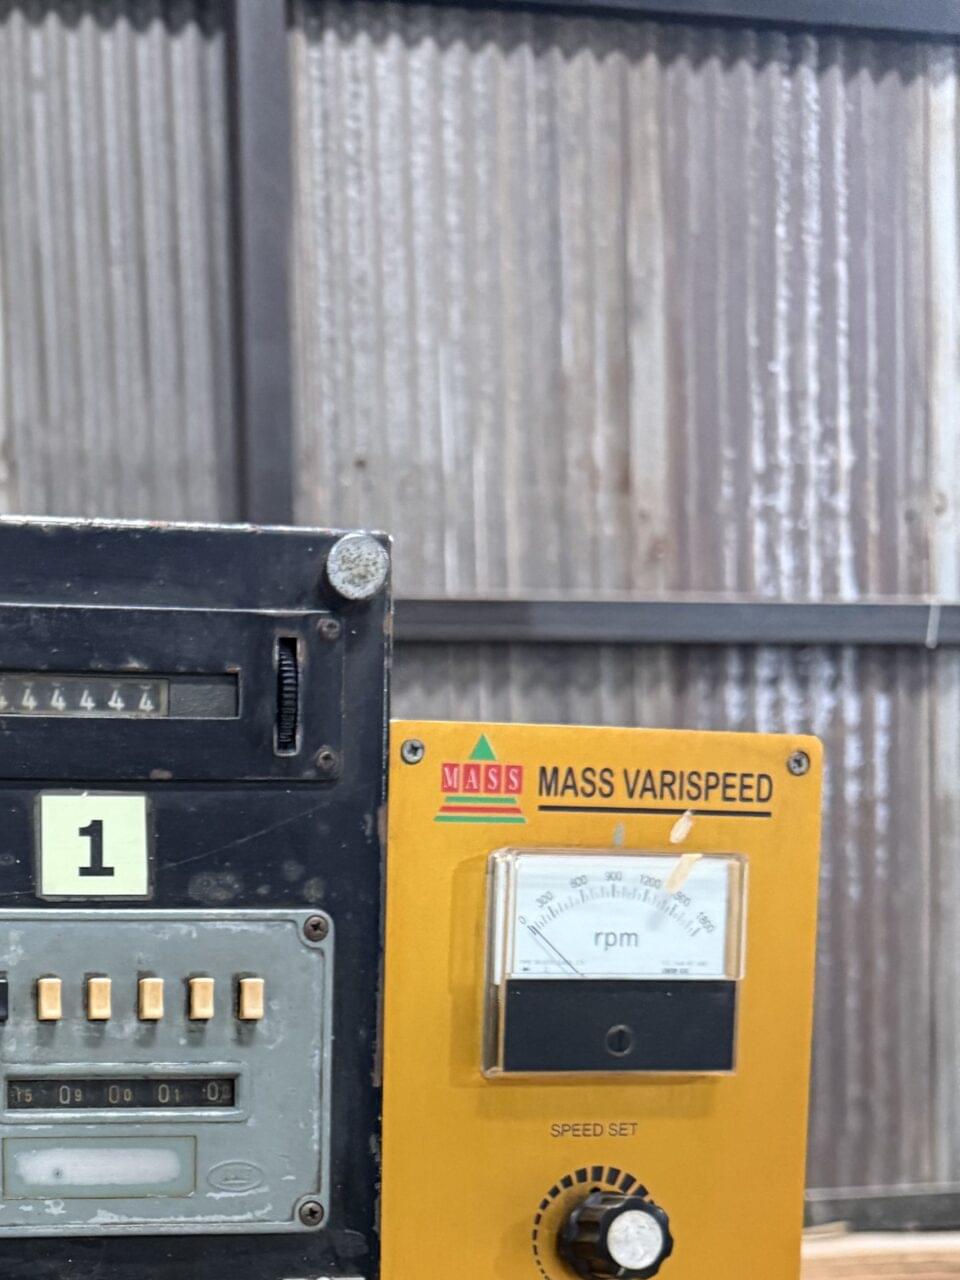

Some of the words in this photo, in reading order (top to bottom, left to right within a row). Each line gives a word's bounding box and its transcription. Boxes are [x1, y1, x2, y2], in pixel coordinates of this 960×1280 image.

[442, 765, 522, 792] MASS
[538, 766, 615, 799] MASS
[624, 768, 774, 803] VARISPEED
[79, 819, 114, 876] 1
[672, 891, 692, 908] 500
[594, 931, 639, 950] rpm
[550, 1123, 604, 1137] SPEED
[608, 1122, 638, 1136] SET
